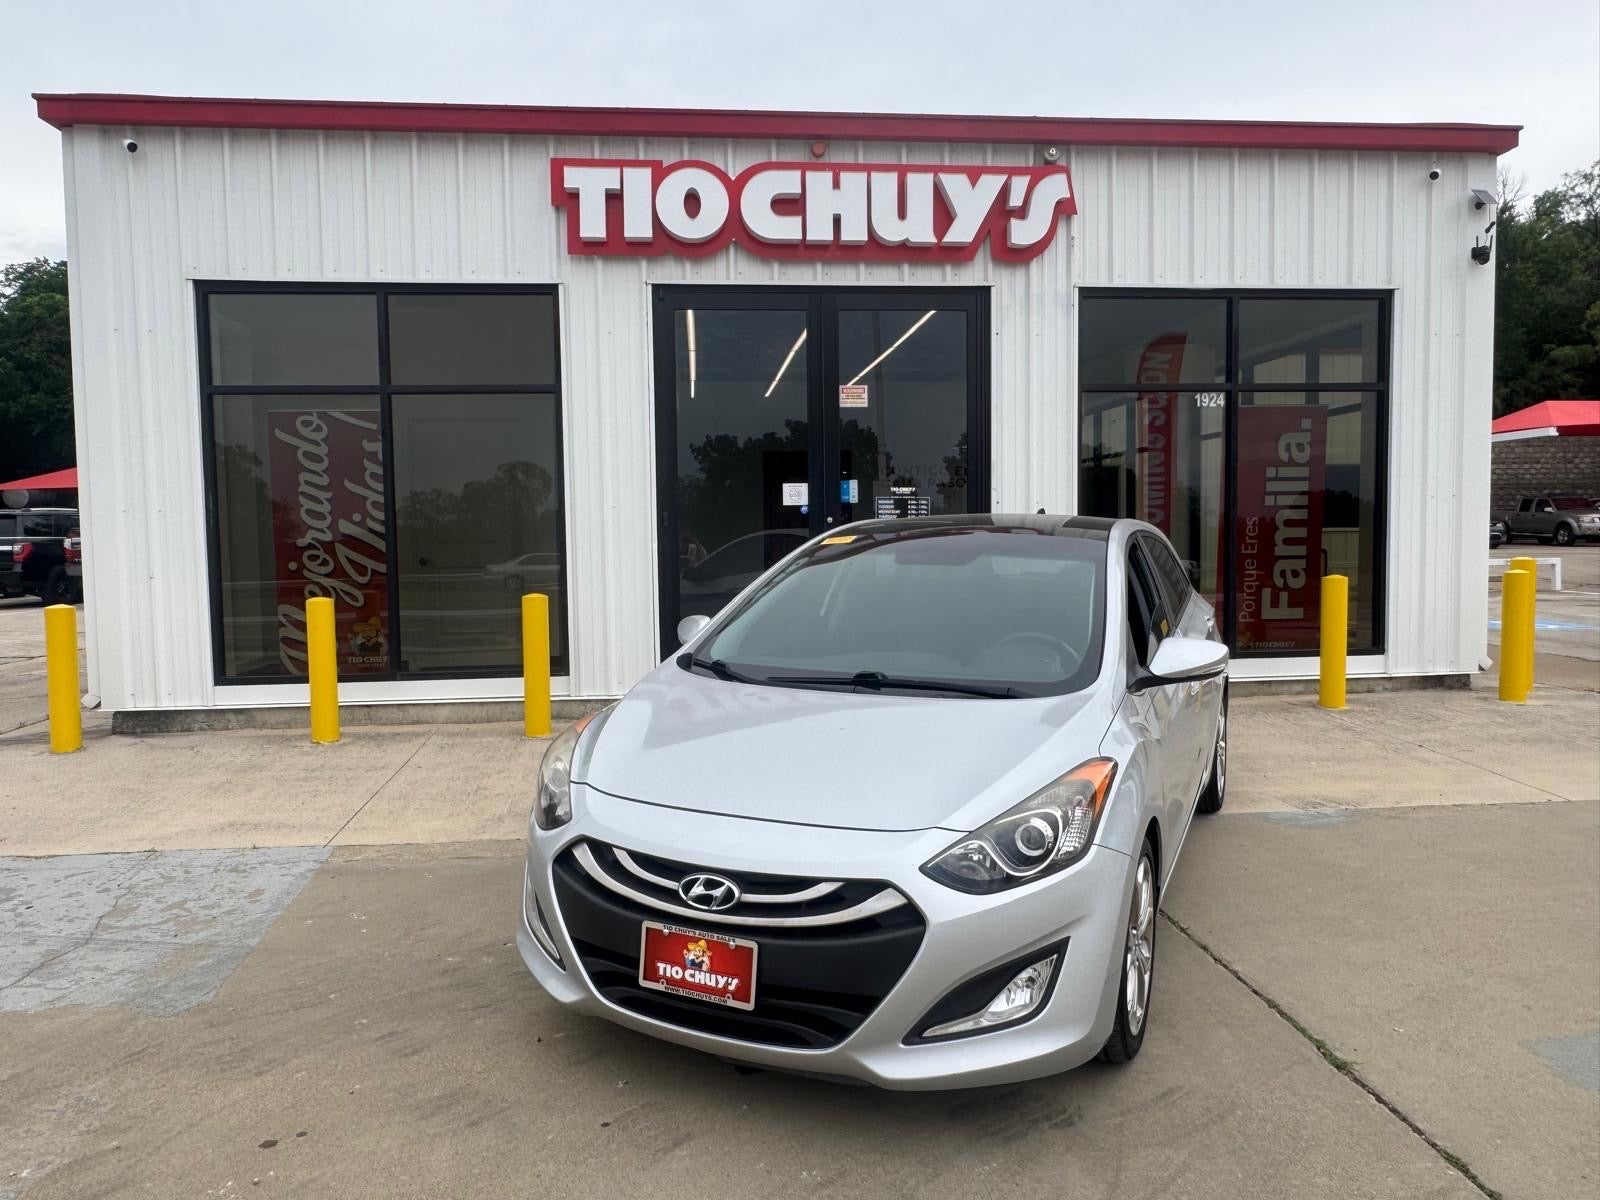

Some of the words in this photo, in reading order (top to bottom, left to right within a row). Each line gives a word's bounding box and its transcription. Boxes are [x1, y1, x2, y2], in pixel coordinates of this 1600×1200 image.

[563, 166, 730, 242] TIO
[740, 169, 1070, 250] CHUY'S
[1194, 392, 1225, 408] 1924
[1261, 416, 1312, 620] Familia.
[1240, 516, 1259, 554] Eres
[1239, 558, 1259, 623] Porque
[698, 931, 715, 939] AUTO
[657, 962, 683, 979] TIO
[684, 968, 739, 991] CHUY'S
[664, 985, 728, 1004] WWW.TIOCHUYS.COM
